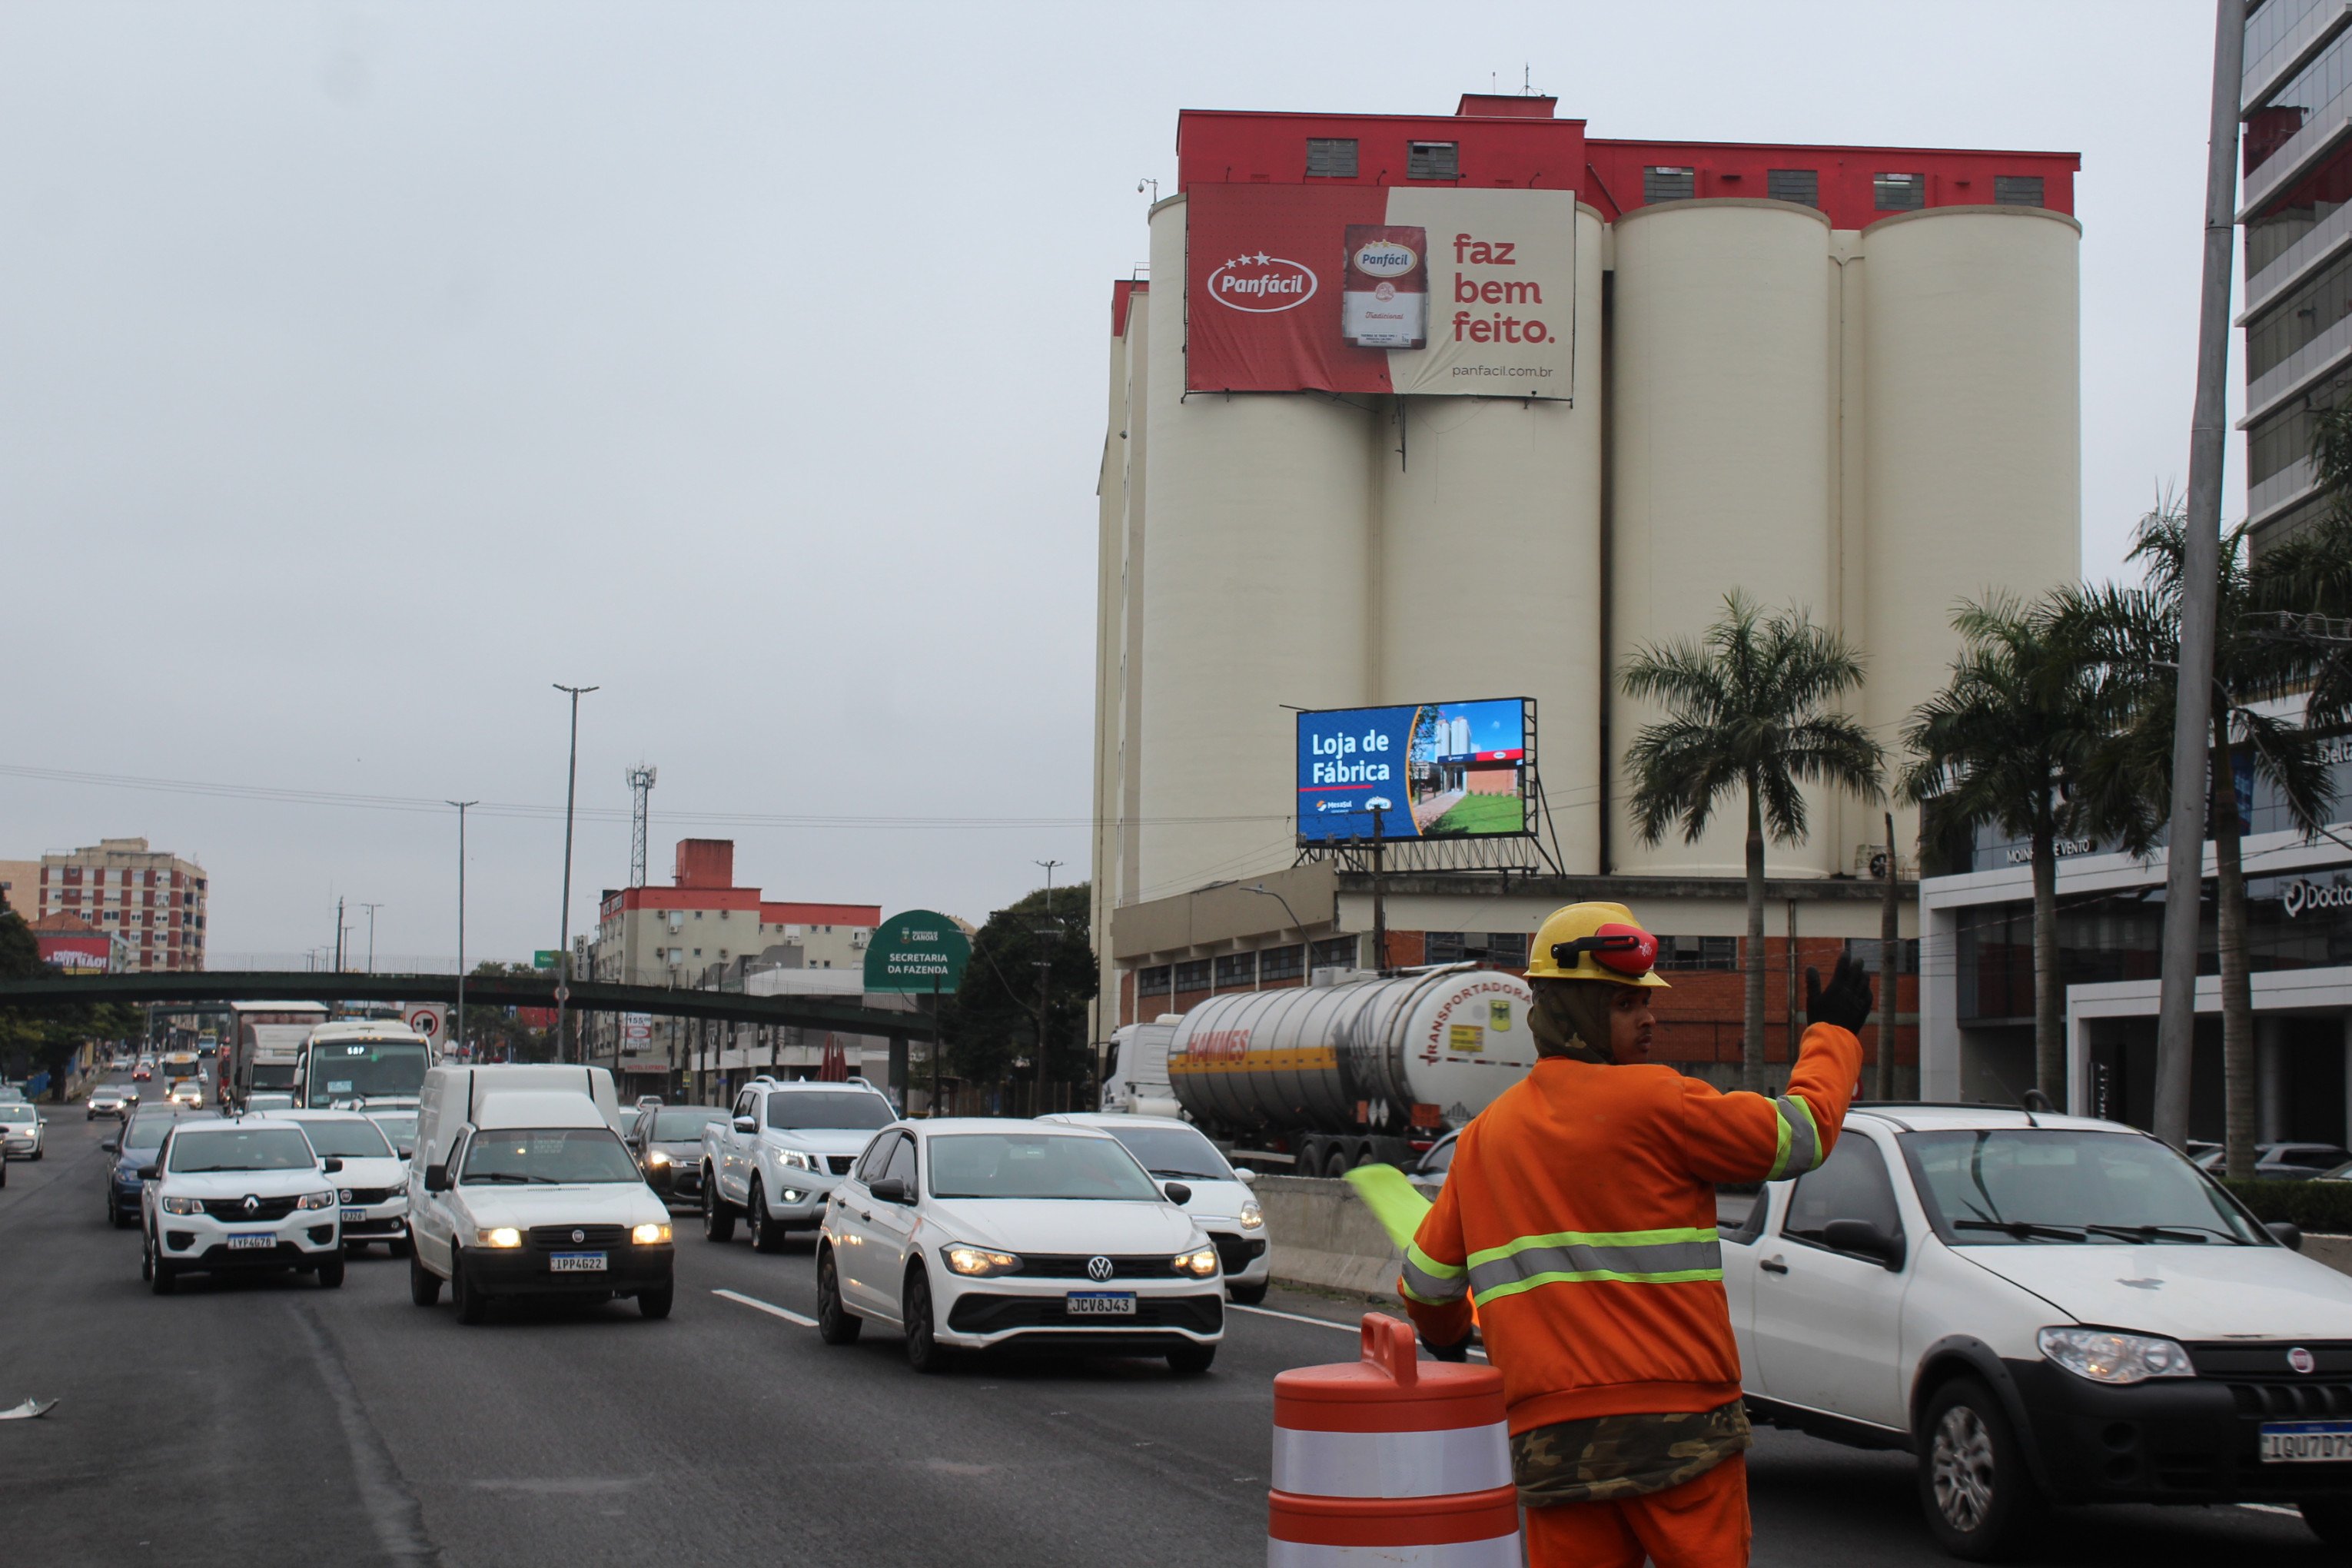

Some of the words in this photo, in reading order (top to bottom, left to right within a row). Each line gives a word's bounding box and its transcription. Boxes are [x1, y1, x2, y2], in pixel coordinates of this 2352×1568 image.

[1453, 233, 1516, 264] faz
[1361, 253, 1408, 267] Panfácil
[1221, 273, 1303, 297] Panfácil
[1454, 272, 1543, 304] bem
[1365, 311, 1405, 320] Tradicional
[1452, 311, 1556, 344] feito.
[1452, 365, 1553, 378] panfacil.com.br
[1312, 732, 1357, 759] Loja
[1362, 729, 1390, 752] de
[1313, 759, 1390, 784] Fábrica
[2061, 839, 2090, 855] VENTO
[889, 953, 948, 962] SECRETARIA
[888, 965, 902, 974] DA
[903, 965, 948, 975] FAZENDA
[1427, 982, 1533, 1067] TRANSPORTADORA
[1187, 1028, 1250, 1064] HAMMES
[556, 1258, 602, 1270] IPP4G22
[1072, 1298, 1129, 1312] JCV8J43
